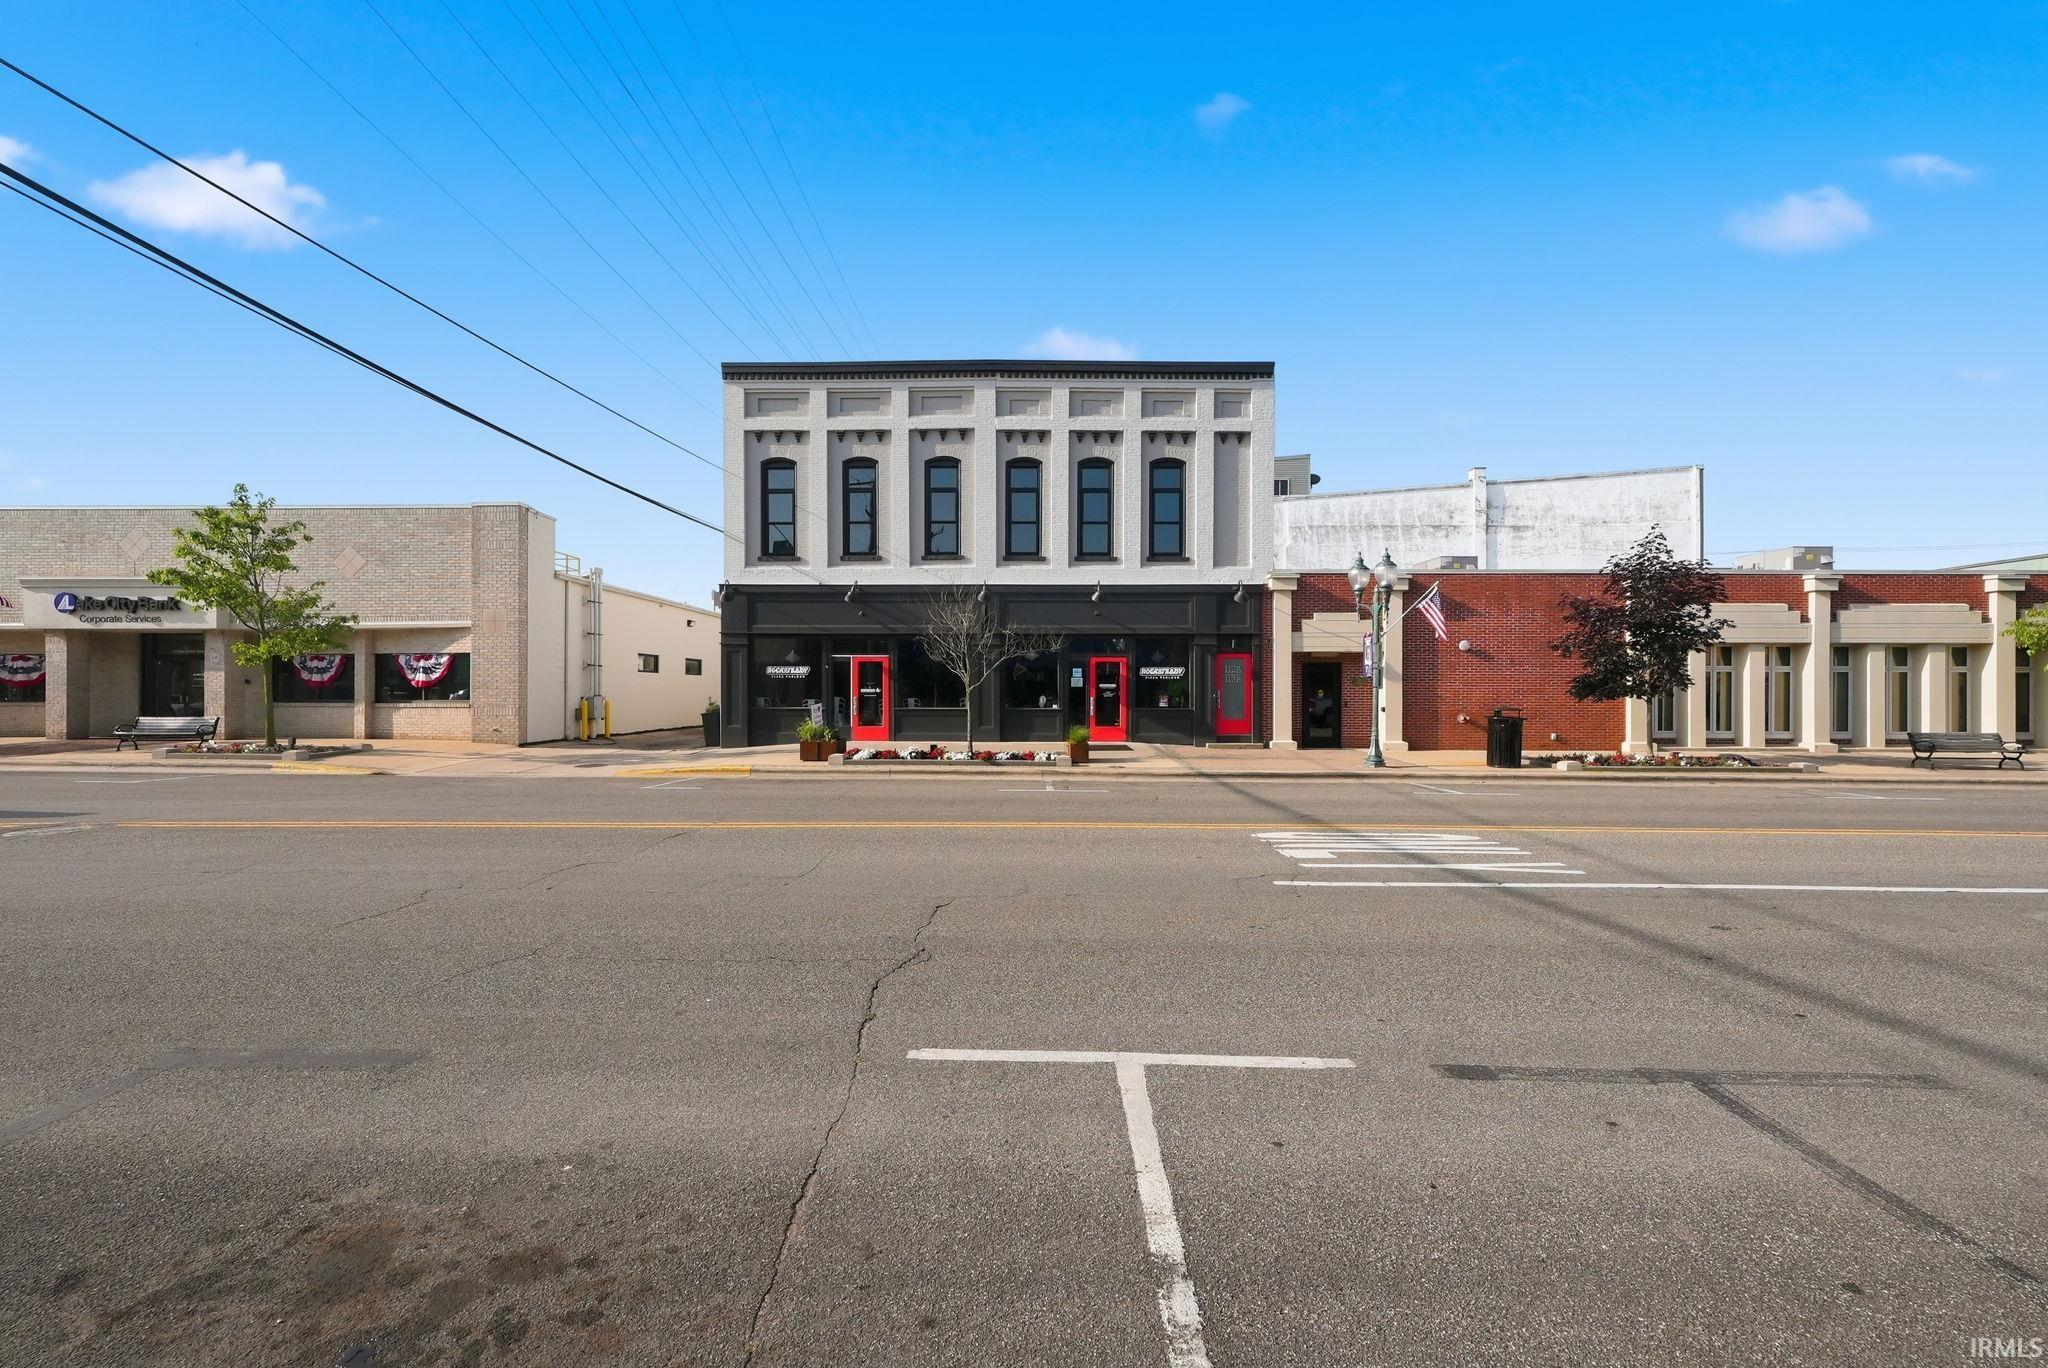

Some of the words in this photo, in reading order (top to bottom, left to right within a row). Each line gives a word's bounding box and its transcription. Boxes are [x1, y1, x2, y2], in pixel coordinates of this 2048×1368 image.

[105, 596, 137, 613] City
[138, 596, 181, 611] Bank
[80, 615, 123, 624] Corporate
[125, 615, 162, 623] Services
